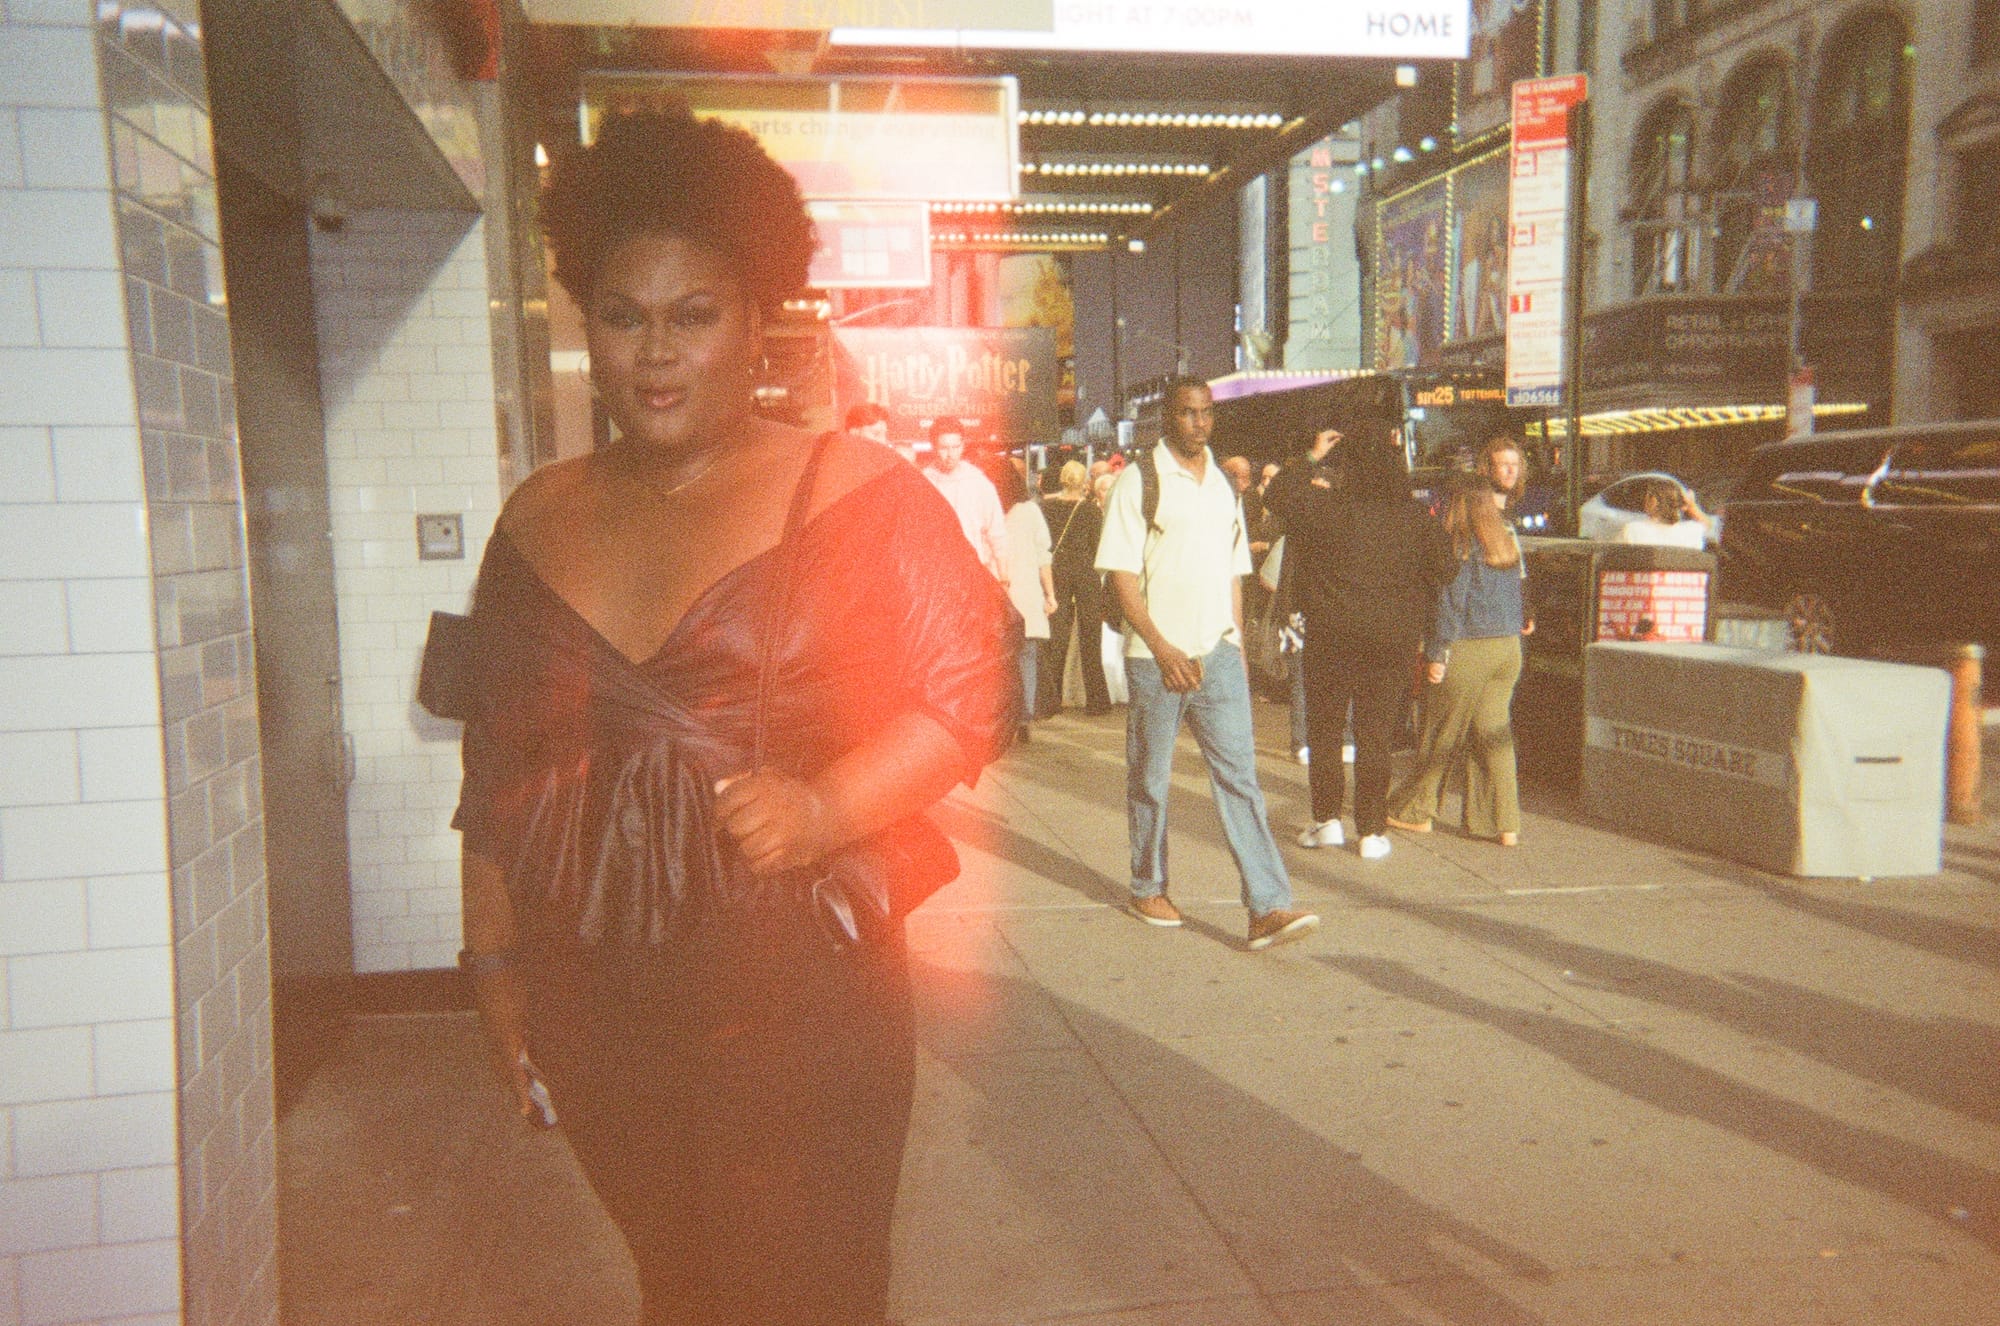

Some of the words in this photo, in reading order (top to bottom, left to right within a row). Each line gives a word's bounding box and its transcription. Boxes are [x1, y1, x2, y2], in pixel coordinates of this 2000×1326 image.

[1126, 5, 1153, 26] AT
[1163, 6, 1255, 28] 7:00PM
[1365, 12, 1453, 37] HOME
[751, 117, 792, 136] arts
[1310, 136, 1332, 340] MSTERDAM
[861, 351, 944, 406] Harry
[948, 343, 1031, 404] Potter
[1613, 725, 1669, 760] TIMES
[1672, 737, 1757, 778] SQUARE
